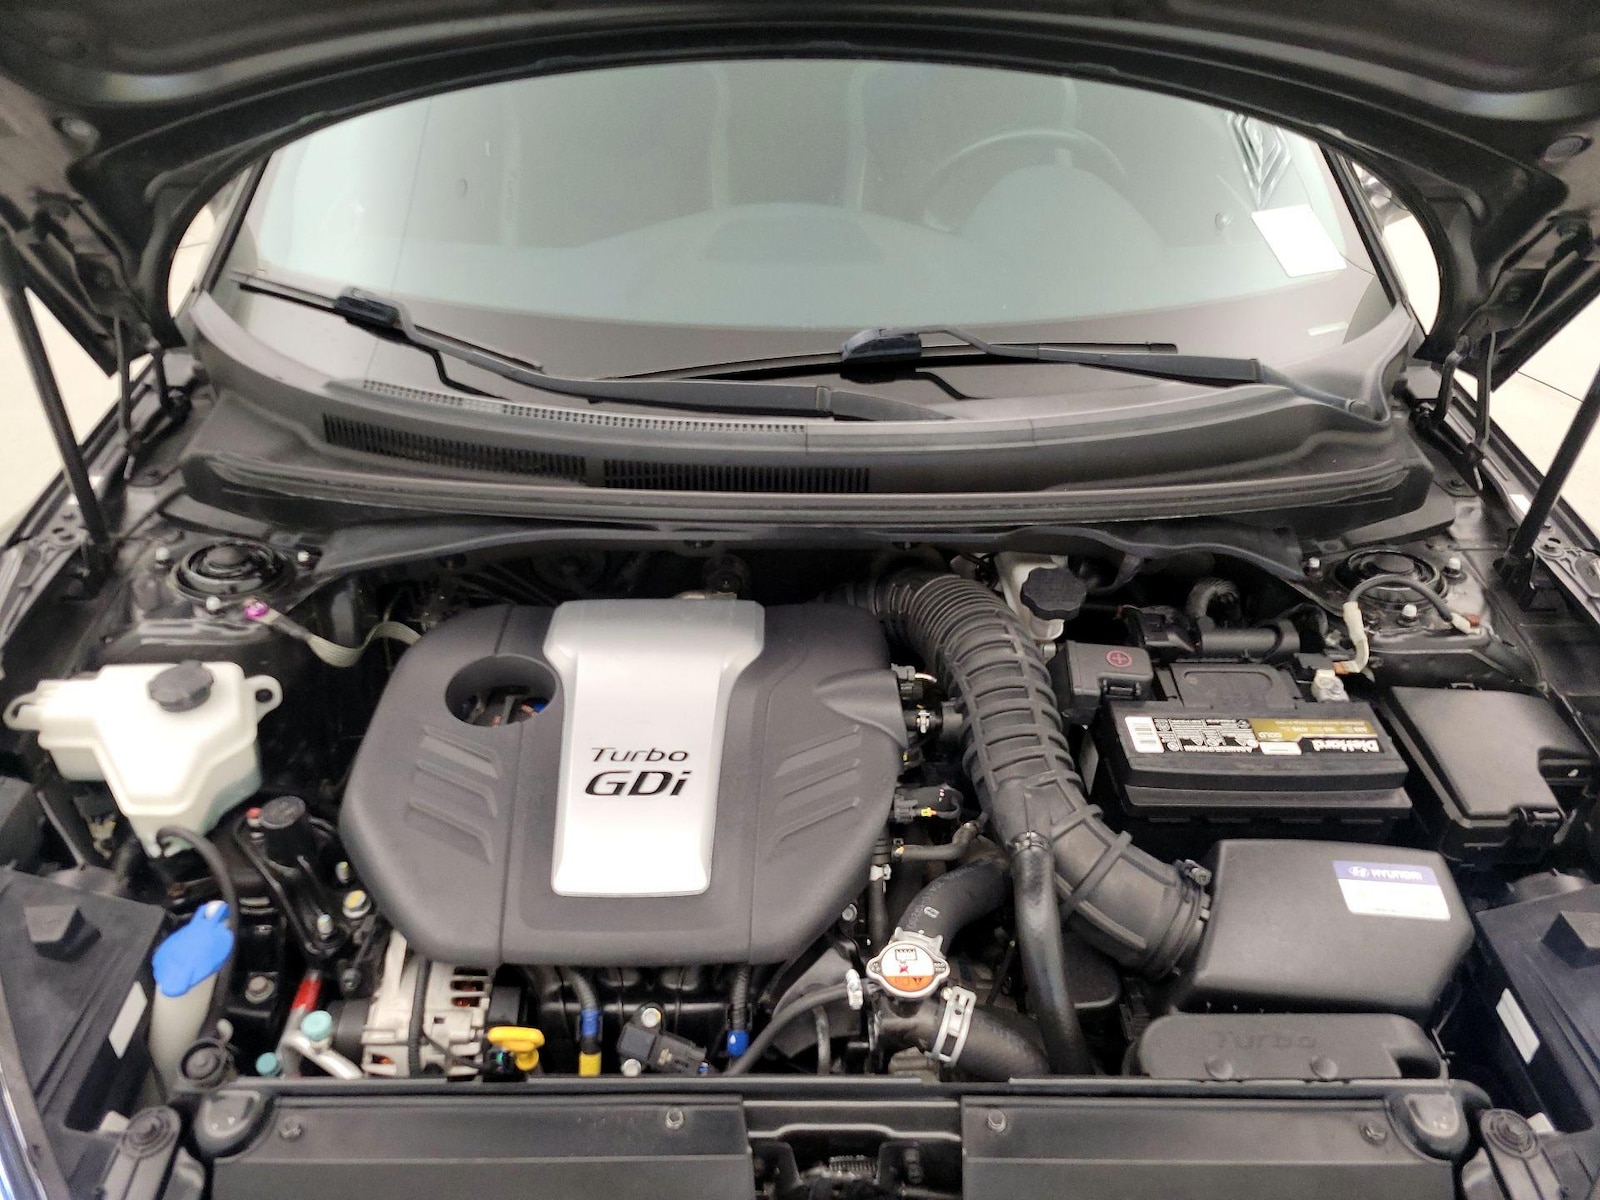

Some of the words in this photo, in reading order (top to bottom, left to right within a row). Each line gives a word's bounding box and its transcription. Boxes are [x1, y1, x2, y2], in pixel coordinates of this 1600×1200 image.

[1311, 739, 1380, 752] DieHard
[592, 747, 689, 762] Turbo
[585, 770, 693, 796] GDi
[1371, 868, 1424, 881] HYUNDAI
